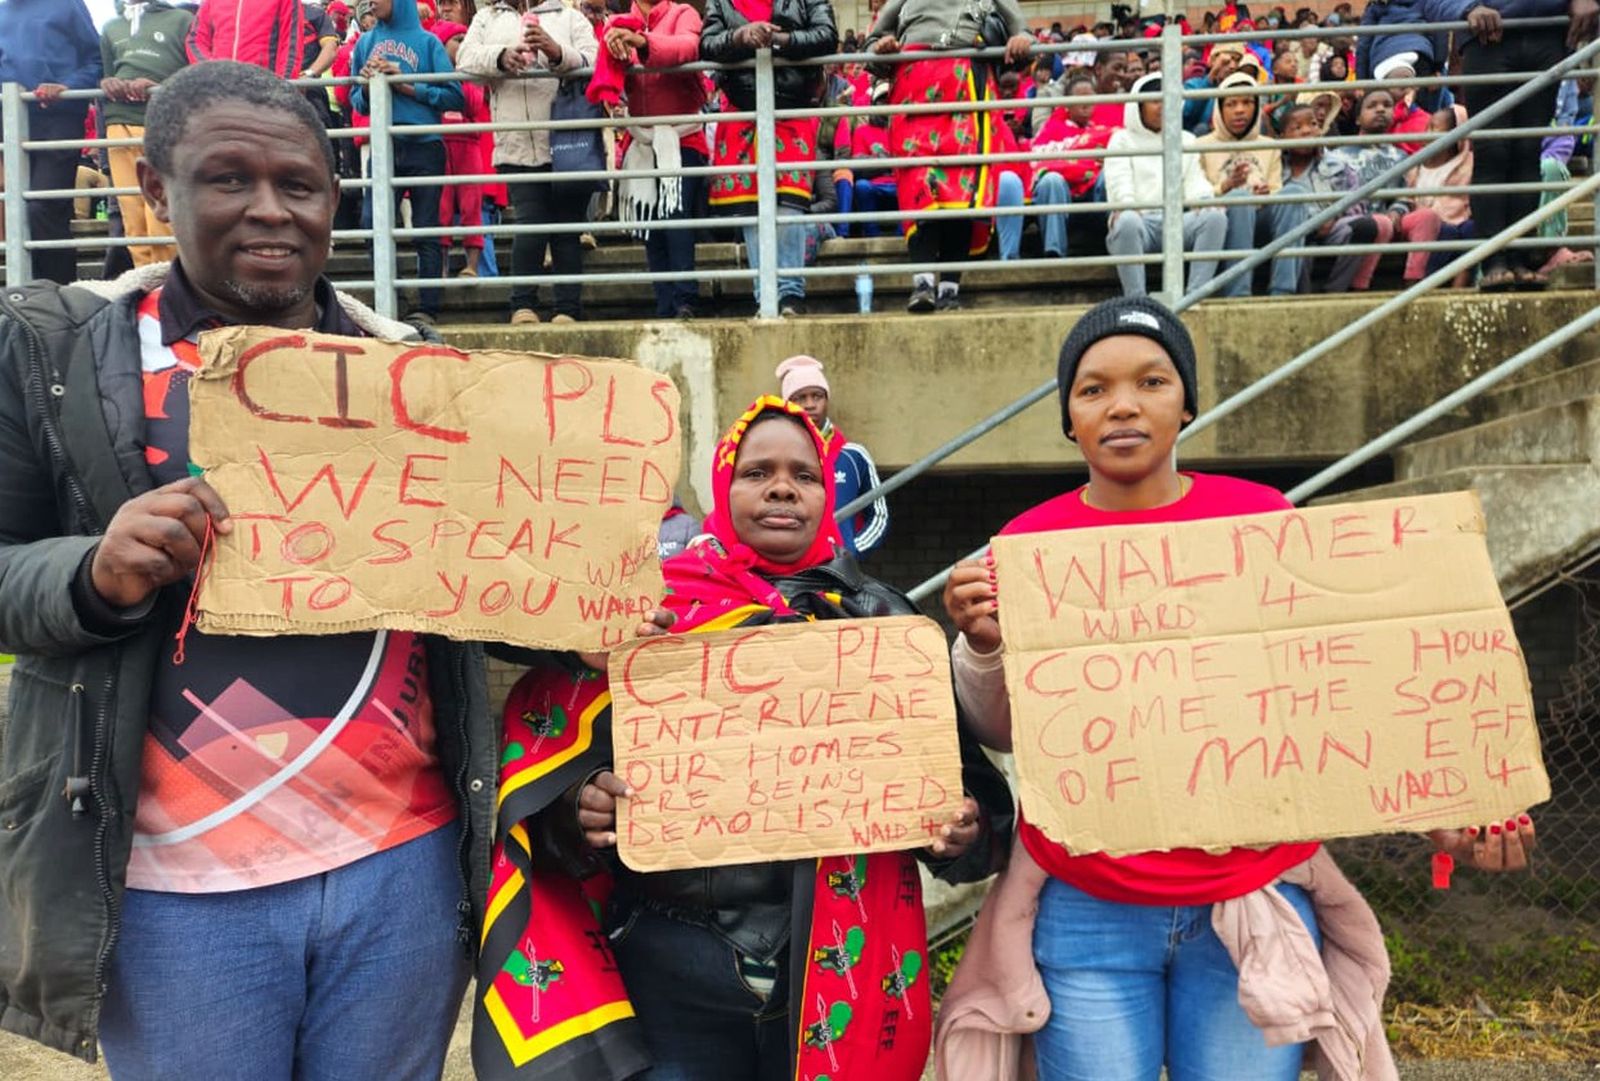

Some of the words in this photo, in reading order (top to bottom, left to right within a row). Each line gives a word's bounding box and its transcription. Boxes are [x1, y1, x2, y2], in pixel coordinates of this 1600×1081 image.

[230, 334, 471, 444] CIC
[543, 358, 675, 446] PLS
[257, 444, 448, 521] WE
[496, 454, 671, 508] NEED
[228, 511, 336, 565] TO
[366, 517, 583, 565] SPEAK
[1033, 505, 1430, 620] WALMER
[265, 575, 352, 621] TO
[422, 570, 560, 617] YOU
[1081, 602, 1197, 642] WARD
[1258, 575, 1327, 618] 4
[622, 629, 785, 708] CIC
[836, 624, 937, 690] PLS
[1024, 641, 1239, 698] COME
[1263, 632, 1373, 673] THE
[1411, 628, 1522, 673] HOUR
[623, 688, 938, 753] INTERVENE
[1038, 694, 1220, 760] COME
[1245, 677, 1354, 727] THE
[1391, 669, 1498, 716] SON
[626, 751, 727, 793] OUR
[747, 731, 904, 778] HOMES
[1056, 757, 1142, 806] OF
[1186, 729, 1373, 798] MAN
[1368, 765, 1469, 815] WARD
[1484, 742, 1533, 788] 4
[627, 774, 948, 847] DEMOLISHED
[628, 789, 709, 818] ARE
[920, 815, 943, 837] 4
